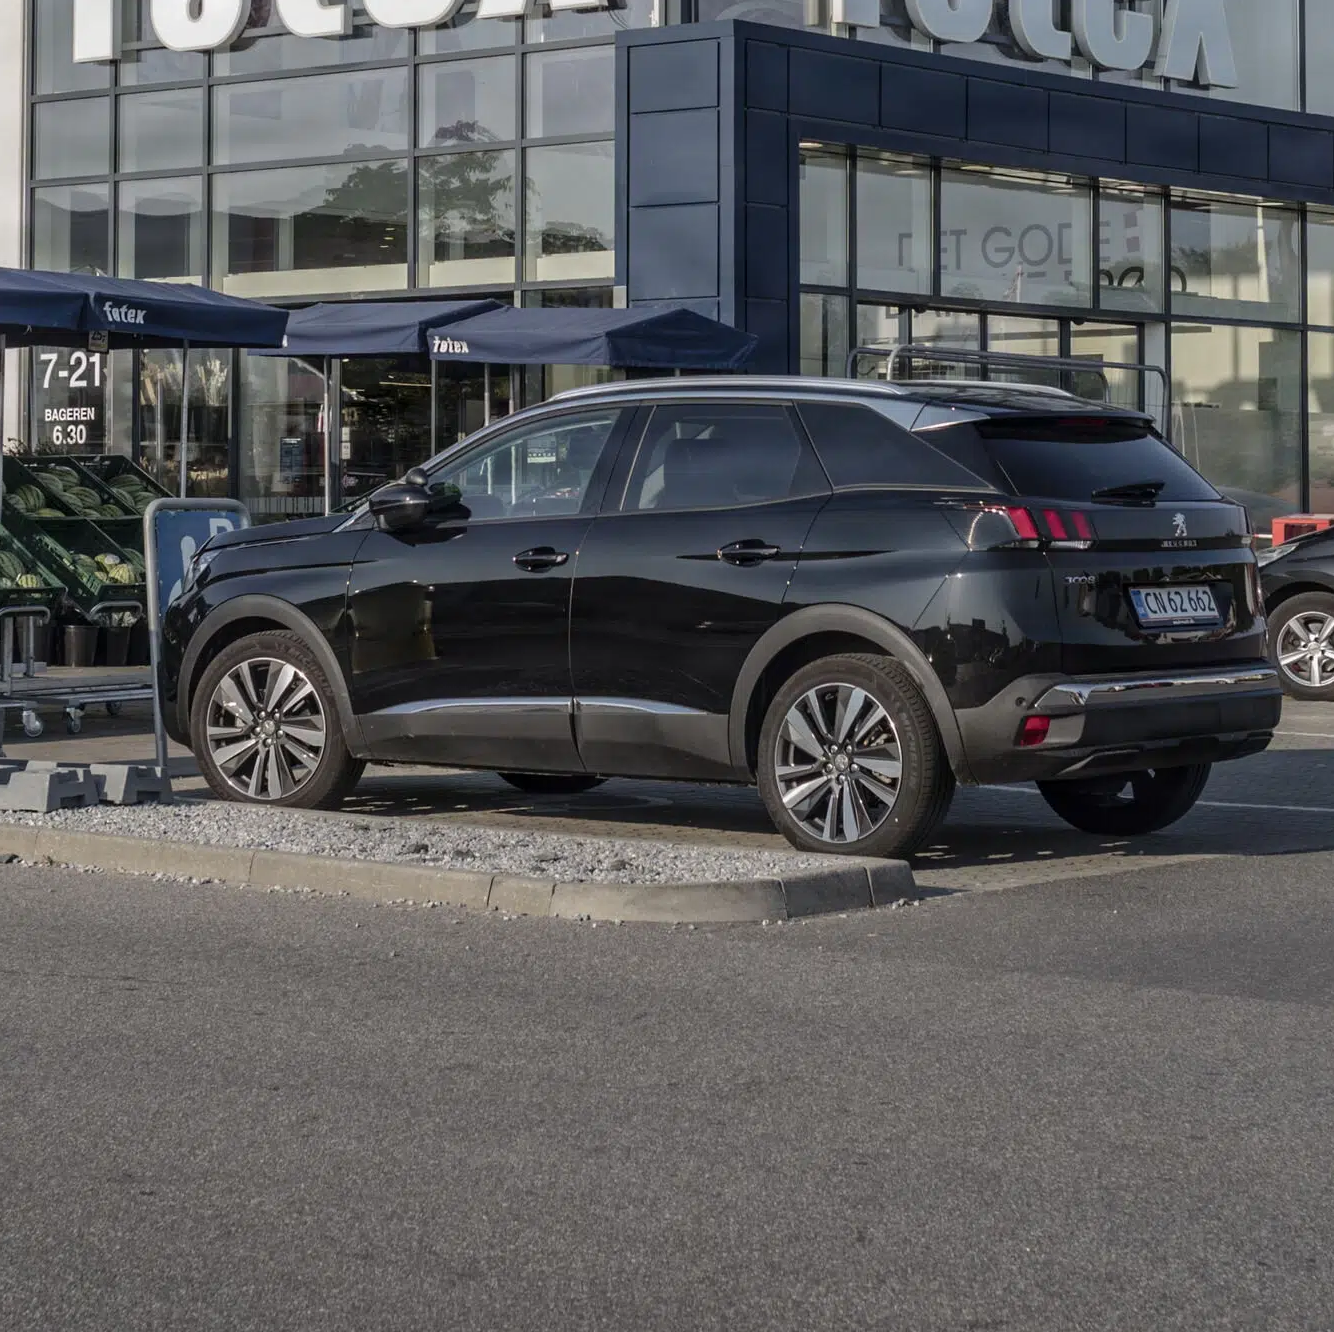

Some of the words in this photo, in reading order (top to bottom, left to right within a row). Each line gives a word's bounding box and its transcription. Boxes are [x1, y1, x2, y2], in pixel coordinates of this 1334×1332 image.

[103, 301, 147, 324] føtex
[433, 335, 469, 354] føtex
[40, 351, 100, 388] 7-21
[45, 407, 95, 421] BAGEREN
[53, 425, 86, 445] 6.30
[1144, 592, 1168, 614] CN
[1168, 591, 1187, 613] 62
[1187, 589, 1215, 613] 662
